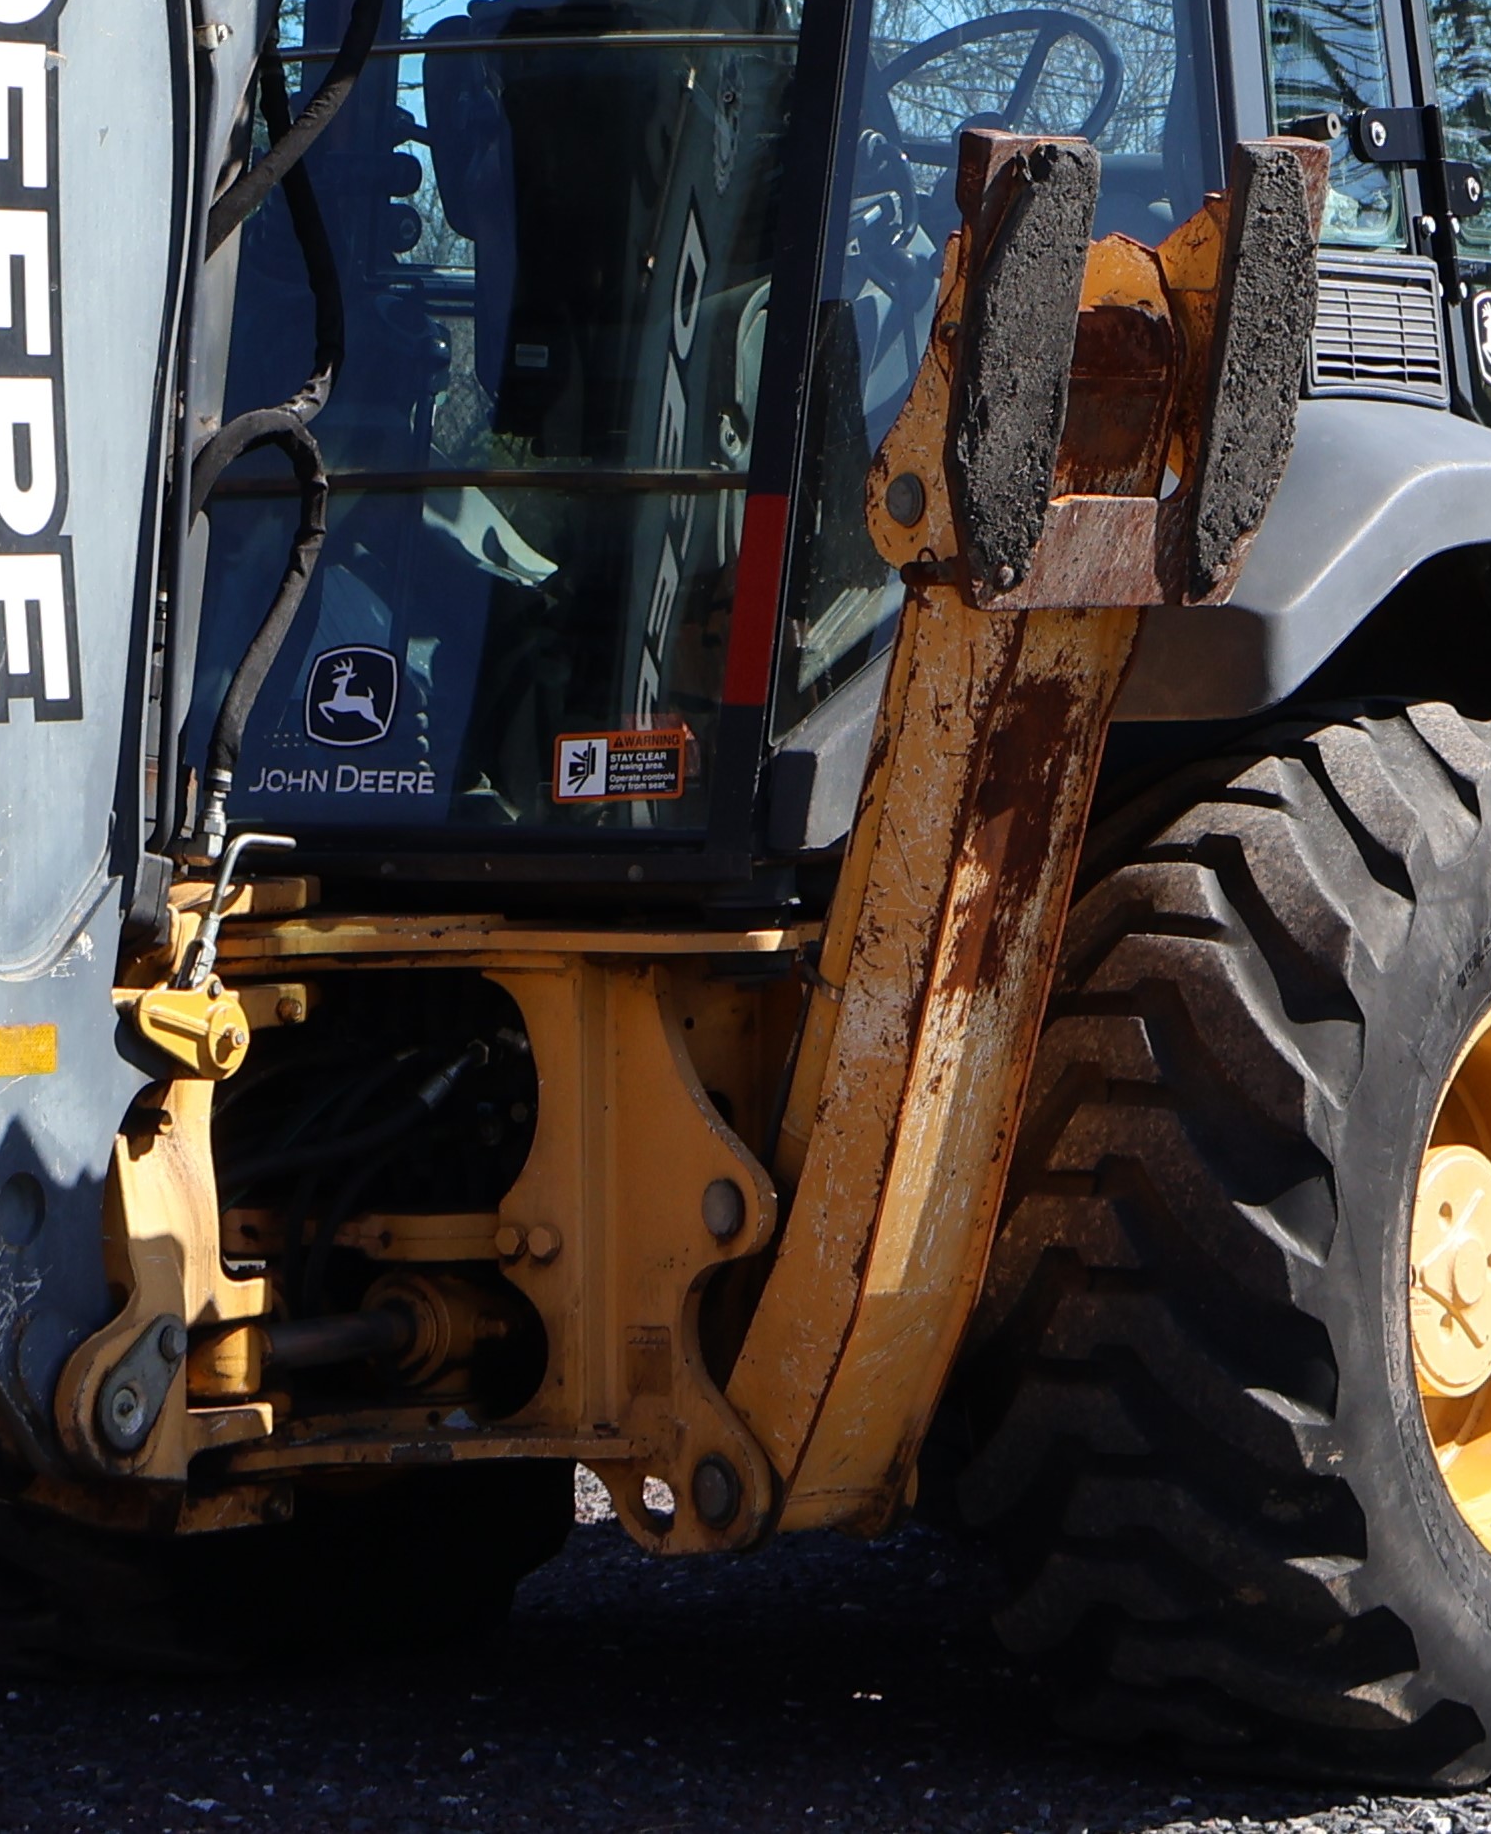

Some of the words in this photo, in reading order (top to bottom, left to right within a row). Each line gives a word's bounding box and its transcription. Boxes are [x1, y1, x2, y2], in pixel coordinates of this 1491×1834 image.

[623, 734, 679, 747] WARNING
[610, 753, 634, 762] STAY
[636, 752, 667, 762] CLEAR
[609, 763, 618, 771] of
[620, 763, 643, 772] swing
[644, 762, 665, 770] area.
[248, 766, 327, 793] JOHN
[336, 764, 436, 795] DEERE
[609, 774, 640, 783] Operate
[642, 772, 675, 781] controls
[609, 783, 626, 792] only
[628, 782, 646, 790] from
[648, 781, 667, 789] seat.
